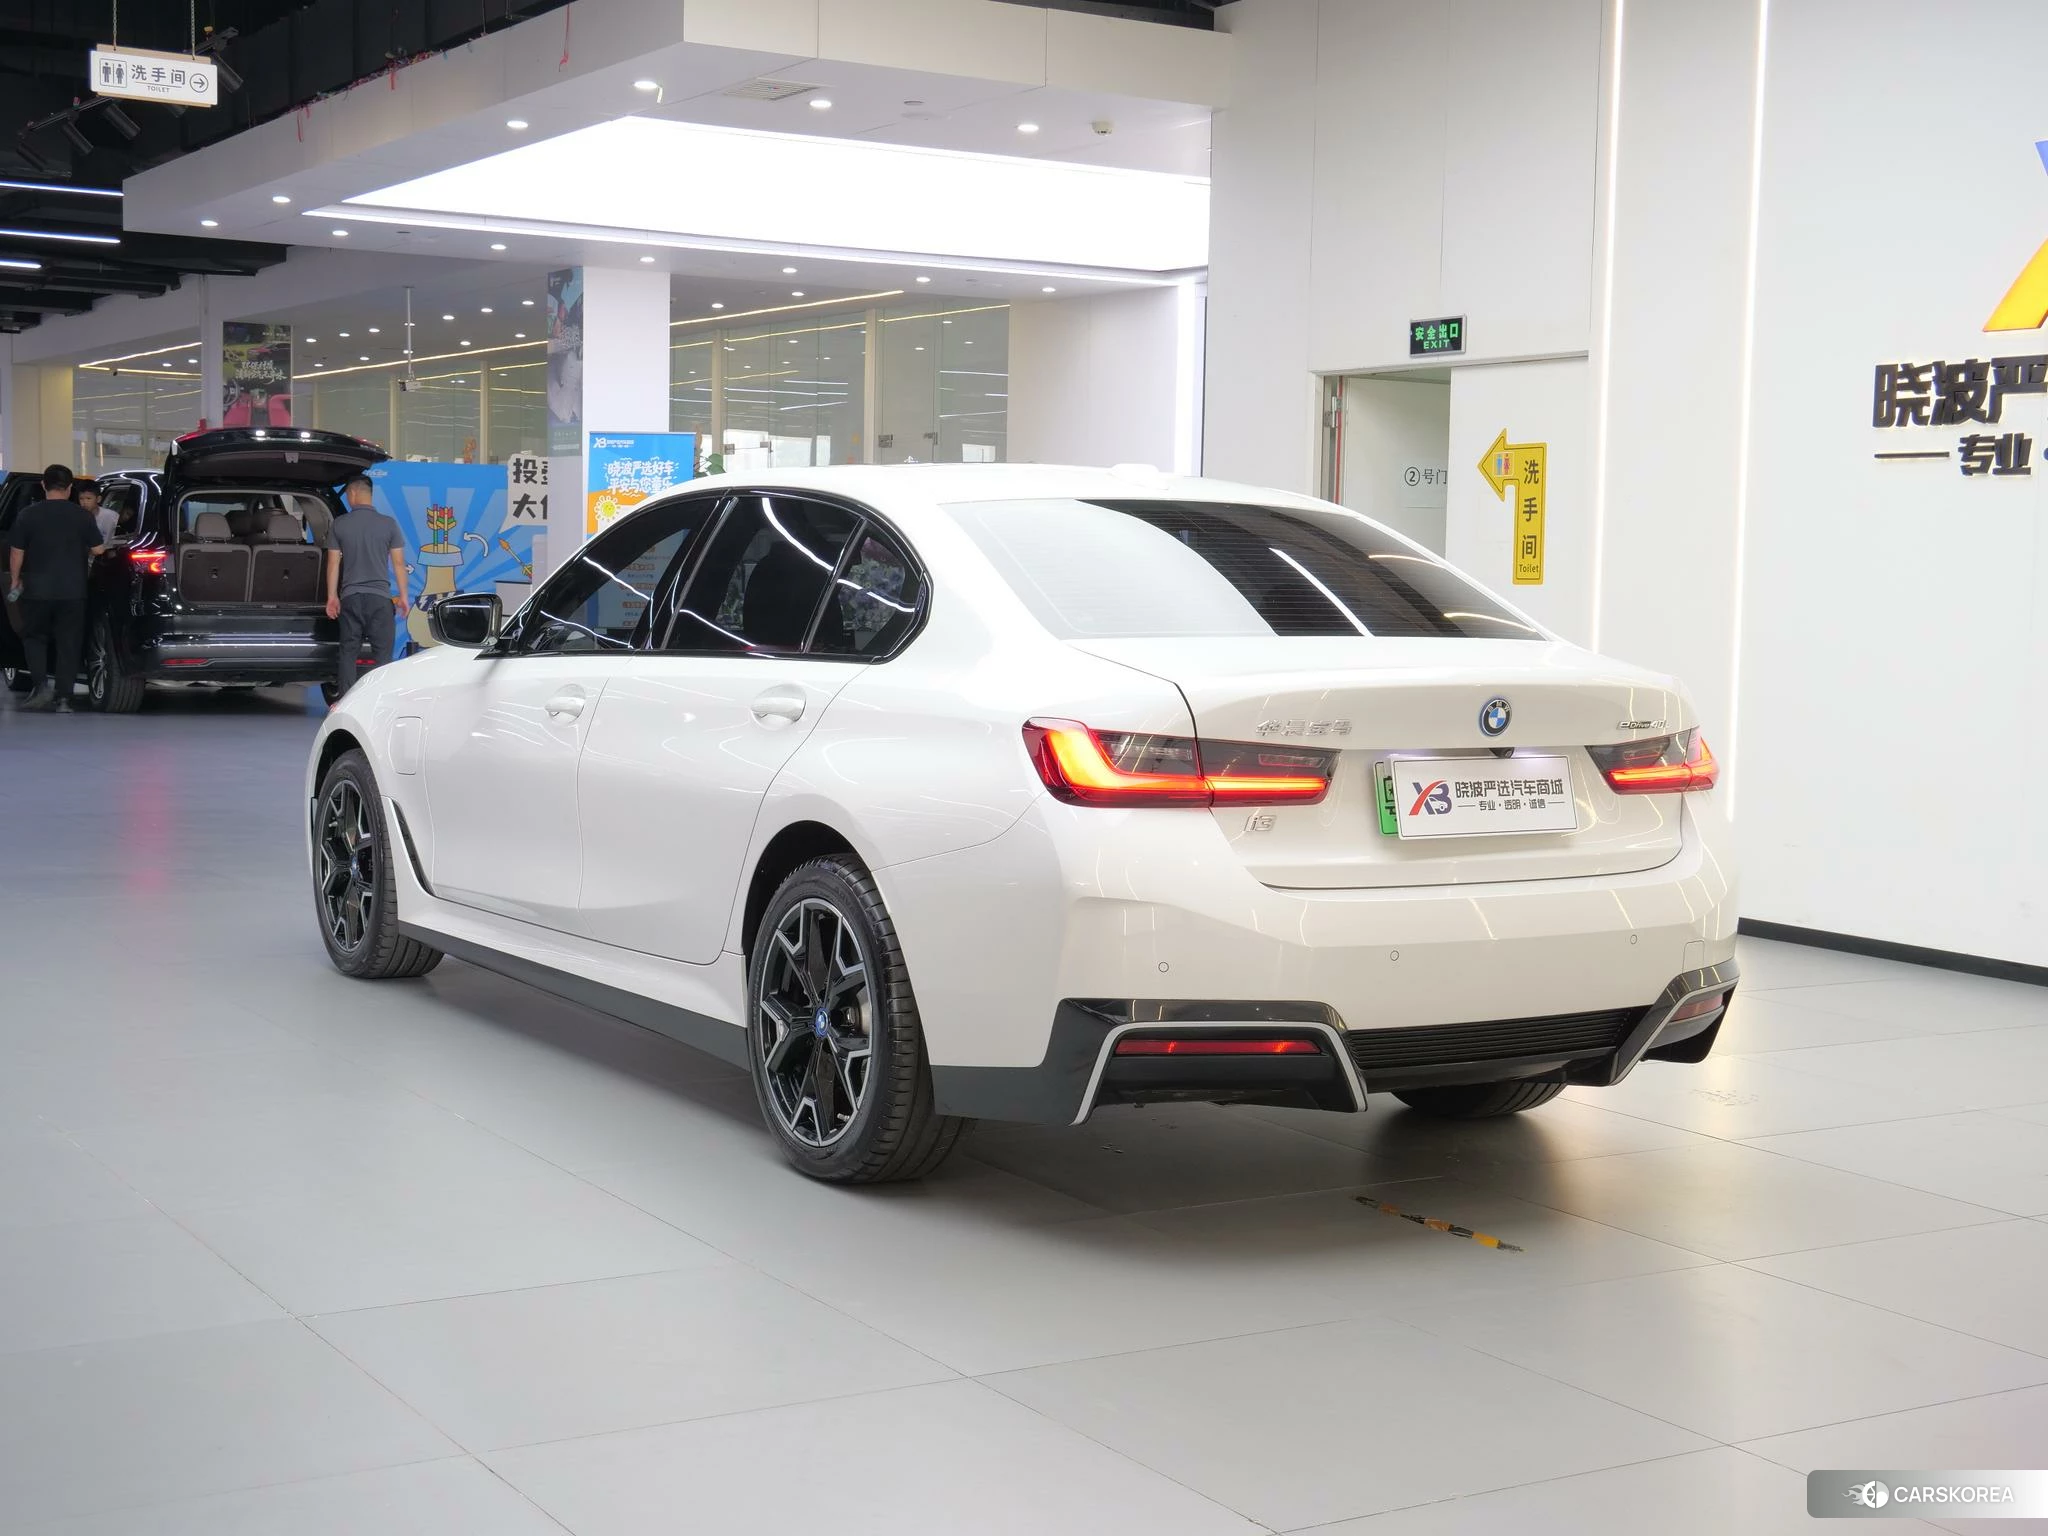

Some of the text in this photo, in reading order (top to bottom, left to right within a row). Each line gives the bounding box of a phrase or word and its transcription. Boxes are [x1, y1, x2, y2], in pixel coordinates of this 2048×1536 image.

[131, 64, 186, 86] 洗手间
[147, 85, 170, 93] TOILET
[1415, 323, 1459, 341] 安全出口
[1423, 339, 1450, 350] EXIT
[1521, 459, 1540, 559] 洗手间
[1519, 563, 1539, 573] Toilet
[1454, 778, 1564, 799] 晓波严选汽车商城
[1245, 814, 1277, 832] i3
